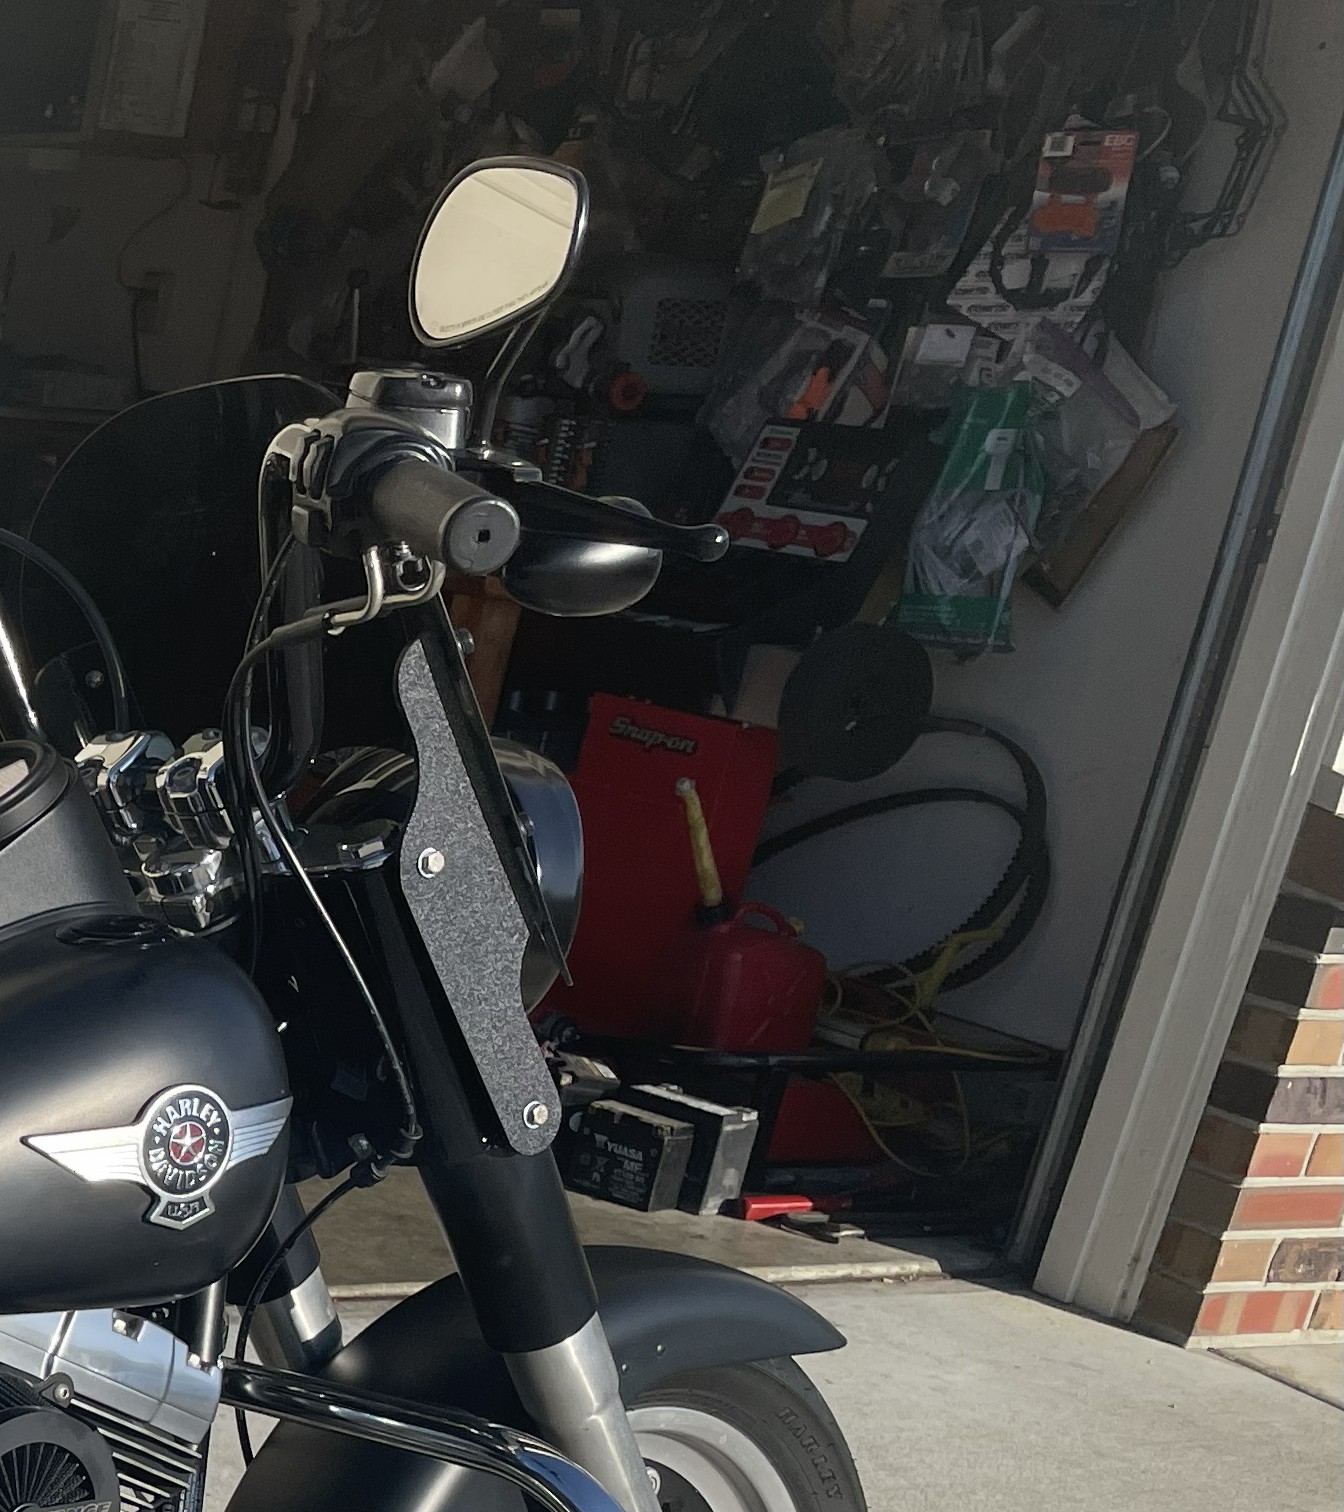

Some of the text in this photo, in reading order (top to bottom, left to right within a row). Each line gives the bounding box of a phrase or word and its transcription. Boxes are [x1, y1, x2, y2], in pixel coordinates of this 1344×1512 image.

[608, 716, 697, 753] Snap-on
[153, 1097, 221, 1136] HARLEY
[148, 1139, 224, 1190] DAVIDSON
[167, 1201, 200, 1217] USA
